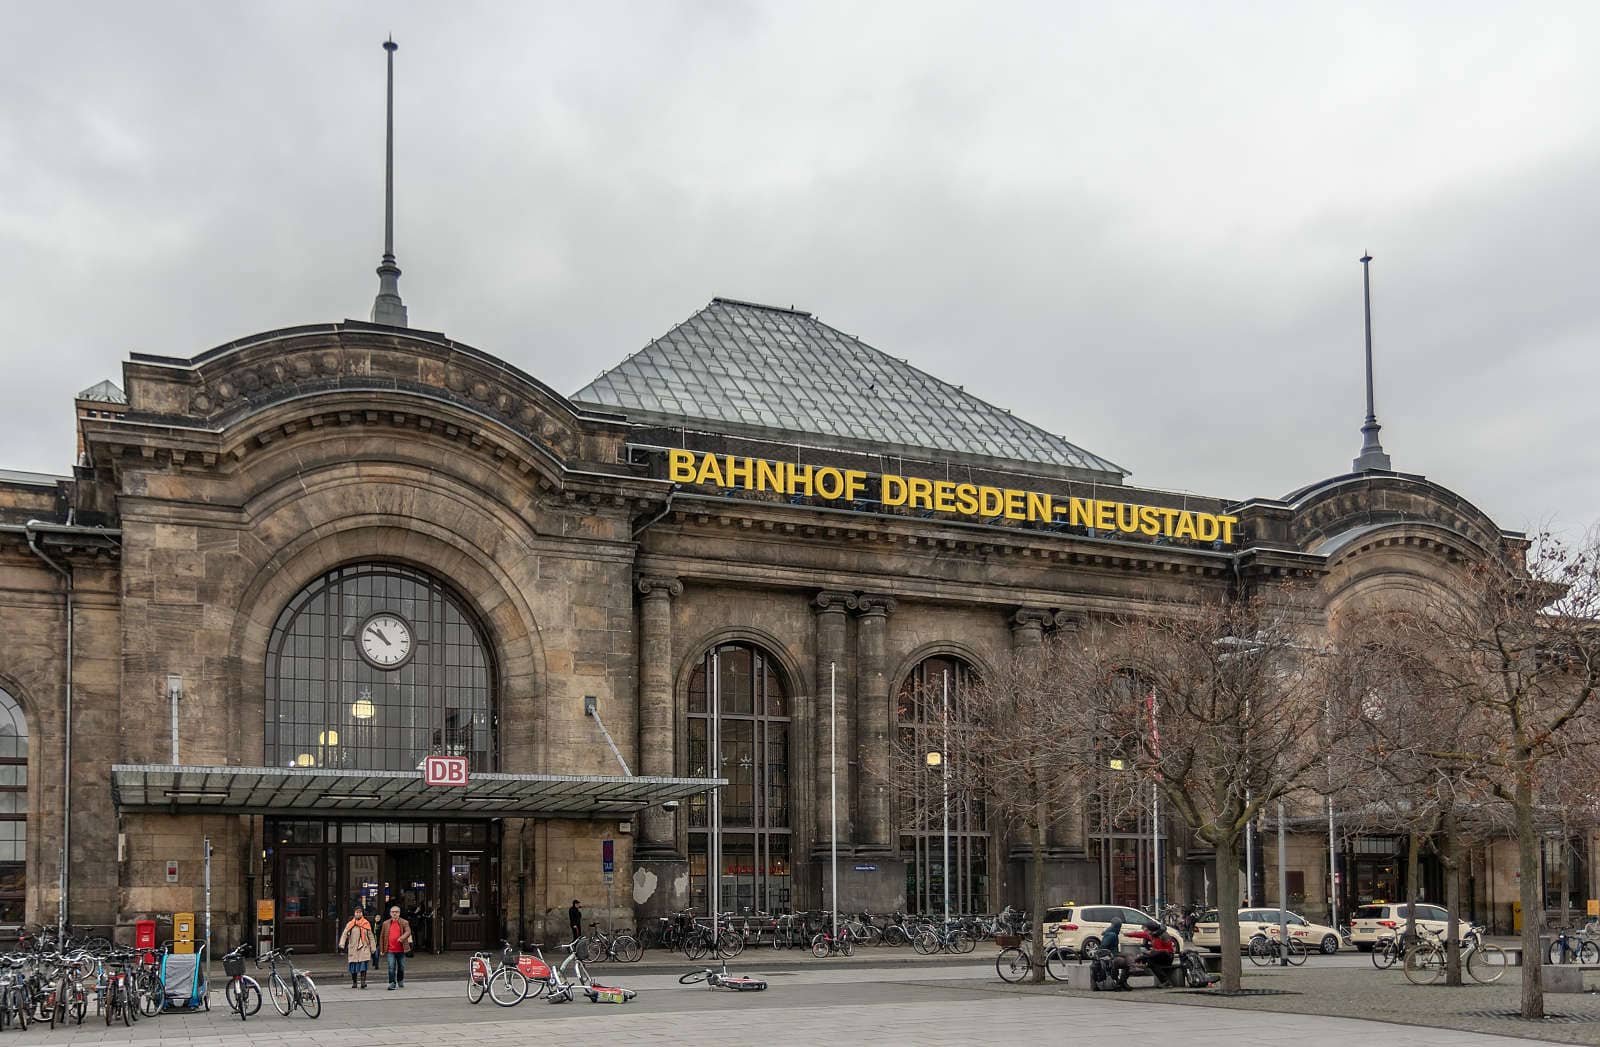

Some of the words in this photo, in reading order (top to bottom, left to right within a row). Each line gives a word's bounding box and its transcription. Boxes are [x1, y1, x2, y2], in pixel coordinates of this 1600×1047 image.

[668, 448, 867, 501] BAHNHOF
[881, 474, 1238, 544] DRESDEN-NEUSTADT
[431, 760, 463, 781] DB
